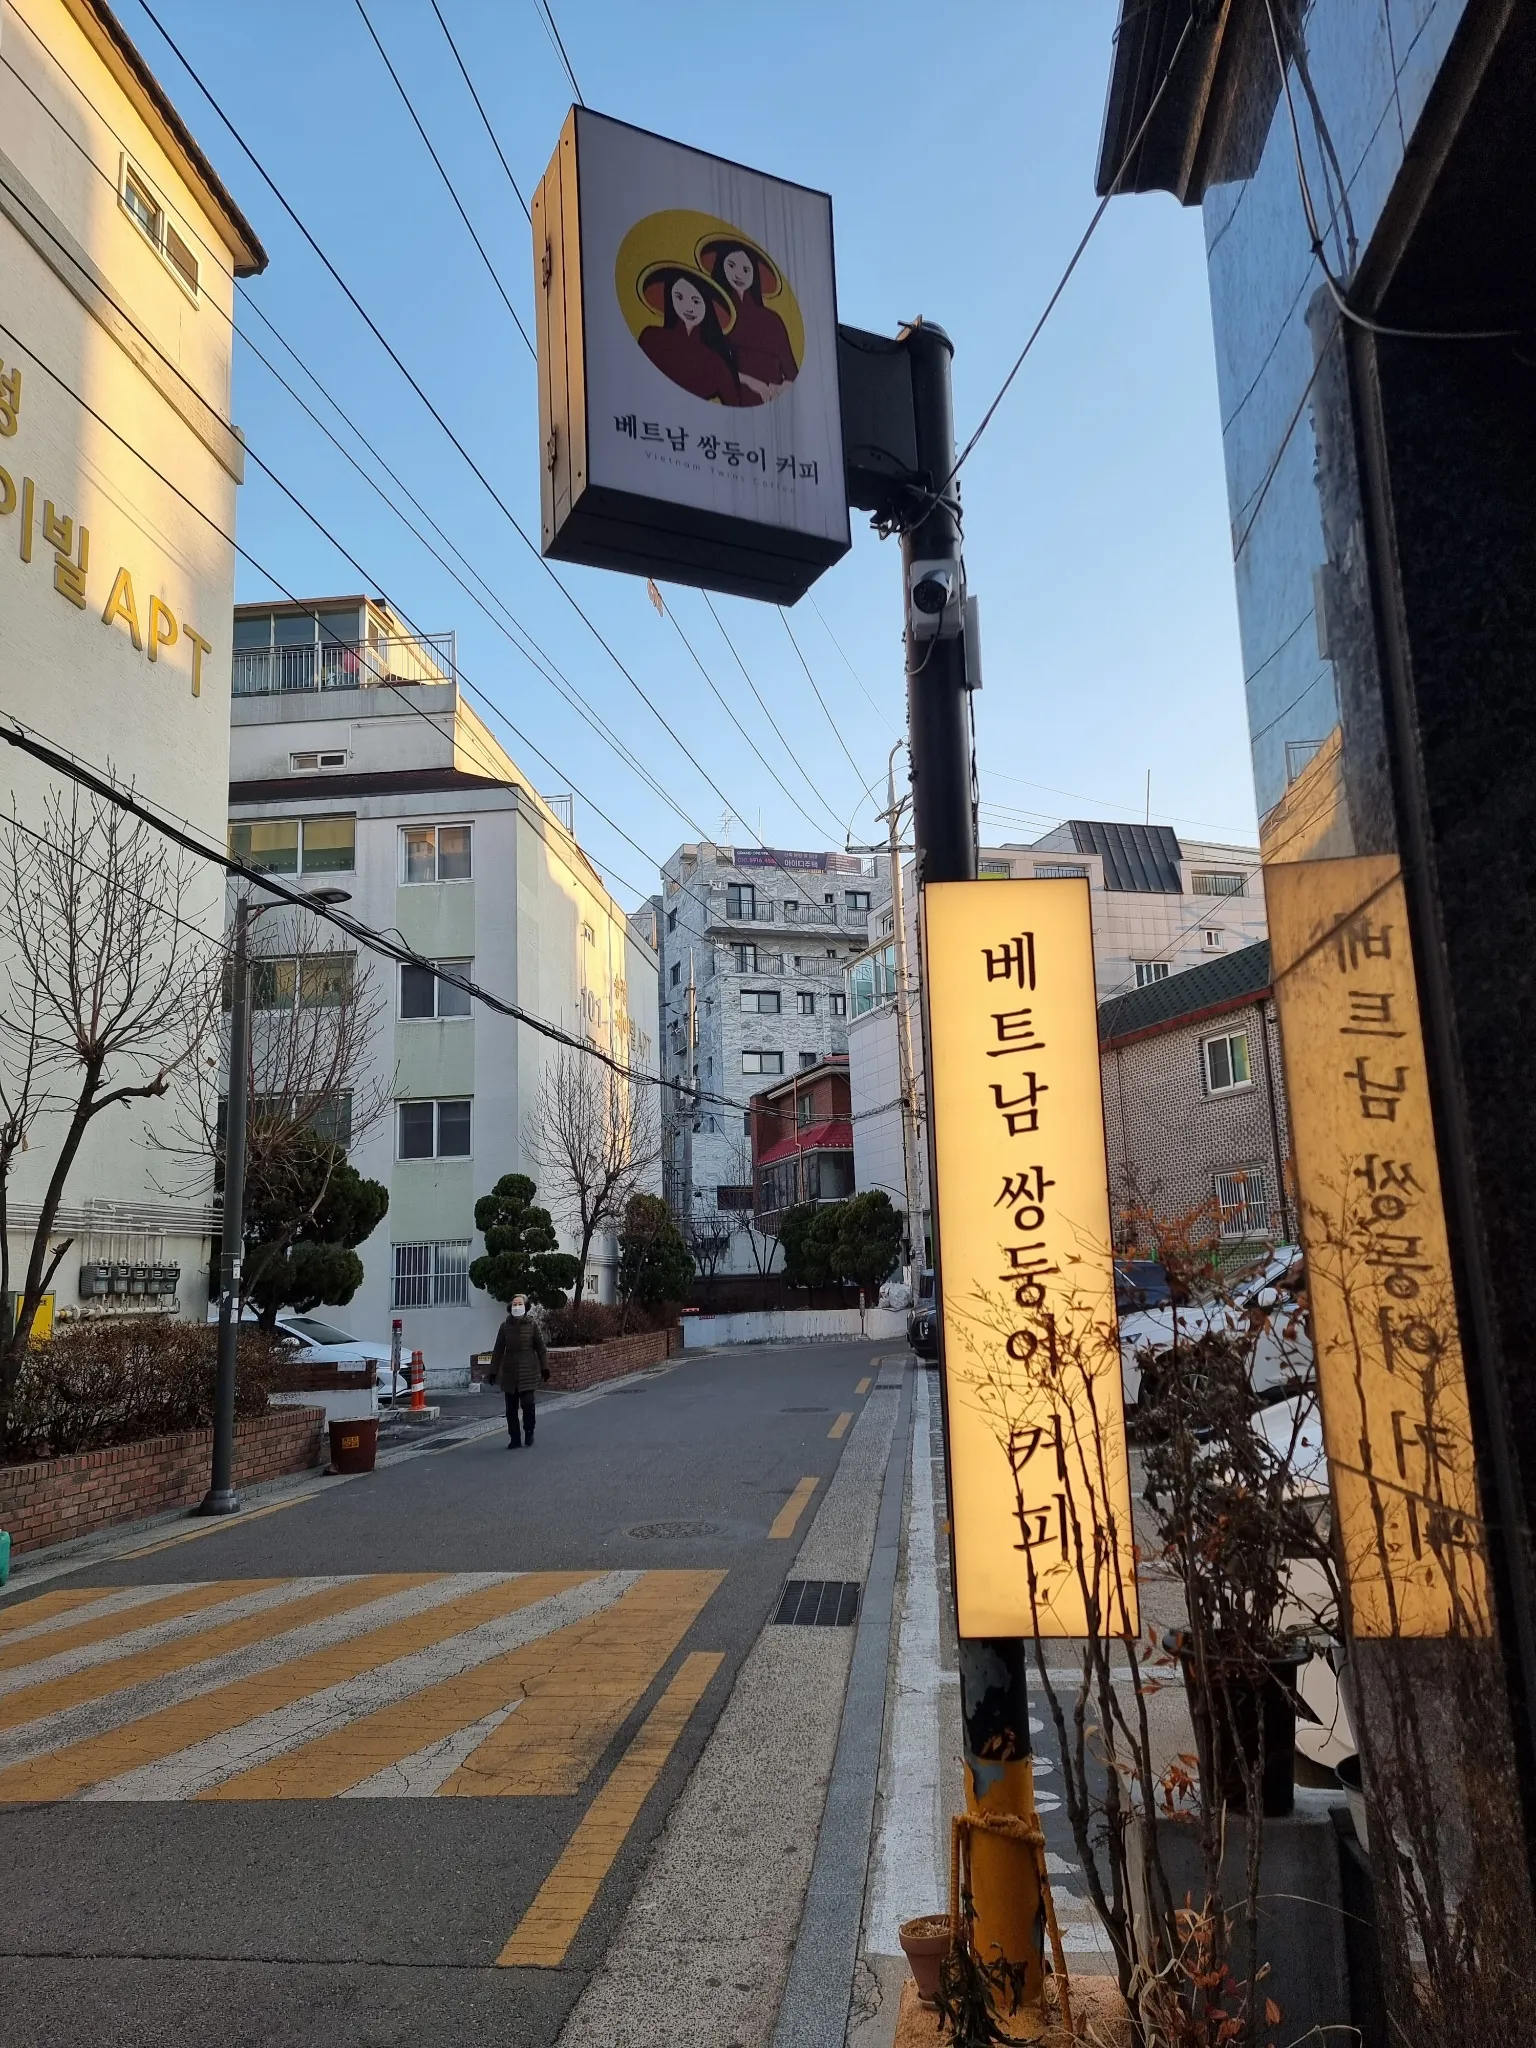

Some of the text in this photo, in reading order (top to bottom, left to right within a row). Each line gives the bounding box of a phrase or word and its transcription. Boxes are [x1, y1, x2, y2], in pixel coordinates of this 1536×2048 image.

[613, 413, 819, 485] 베트남 쌍둥이 커피
[645, 451, 701, 471] Vietnam
[710, 466, 746, 483] Twins
[101, 566, 212, 698] APT
[581, 986, 602, 1029] 101
[981, 931, 1070, 1562] 베트남 쌍둥이 커피
